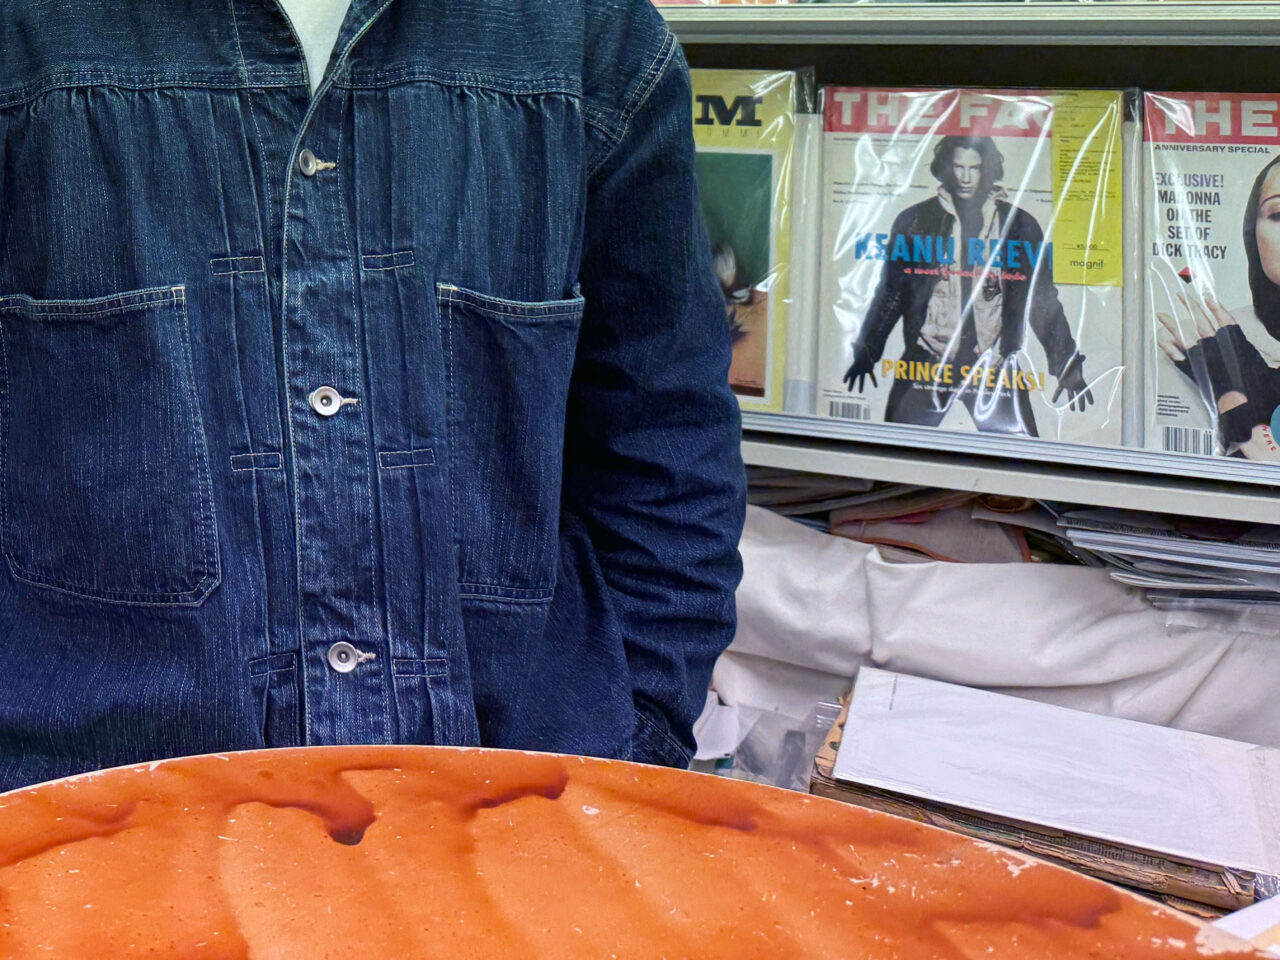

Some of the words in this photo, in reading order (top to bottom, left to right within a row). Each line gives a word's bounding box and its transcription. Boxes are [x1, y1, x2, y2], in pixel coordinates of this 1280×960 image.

[1154, 144, 1226, 153] ANNIVERSARY
[1228, 146, 1271, 154] SPECIAL
[881, 358, 953, 384] PRINCE
